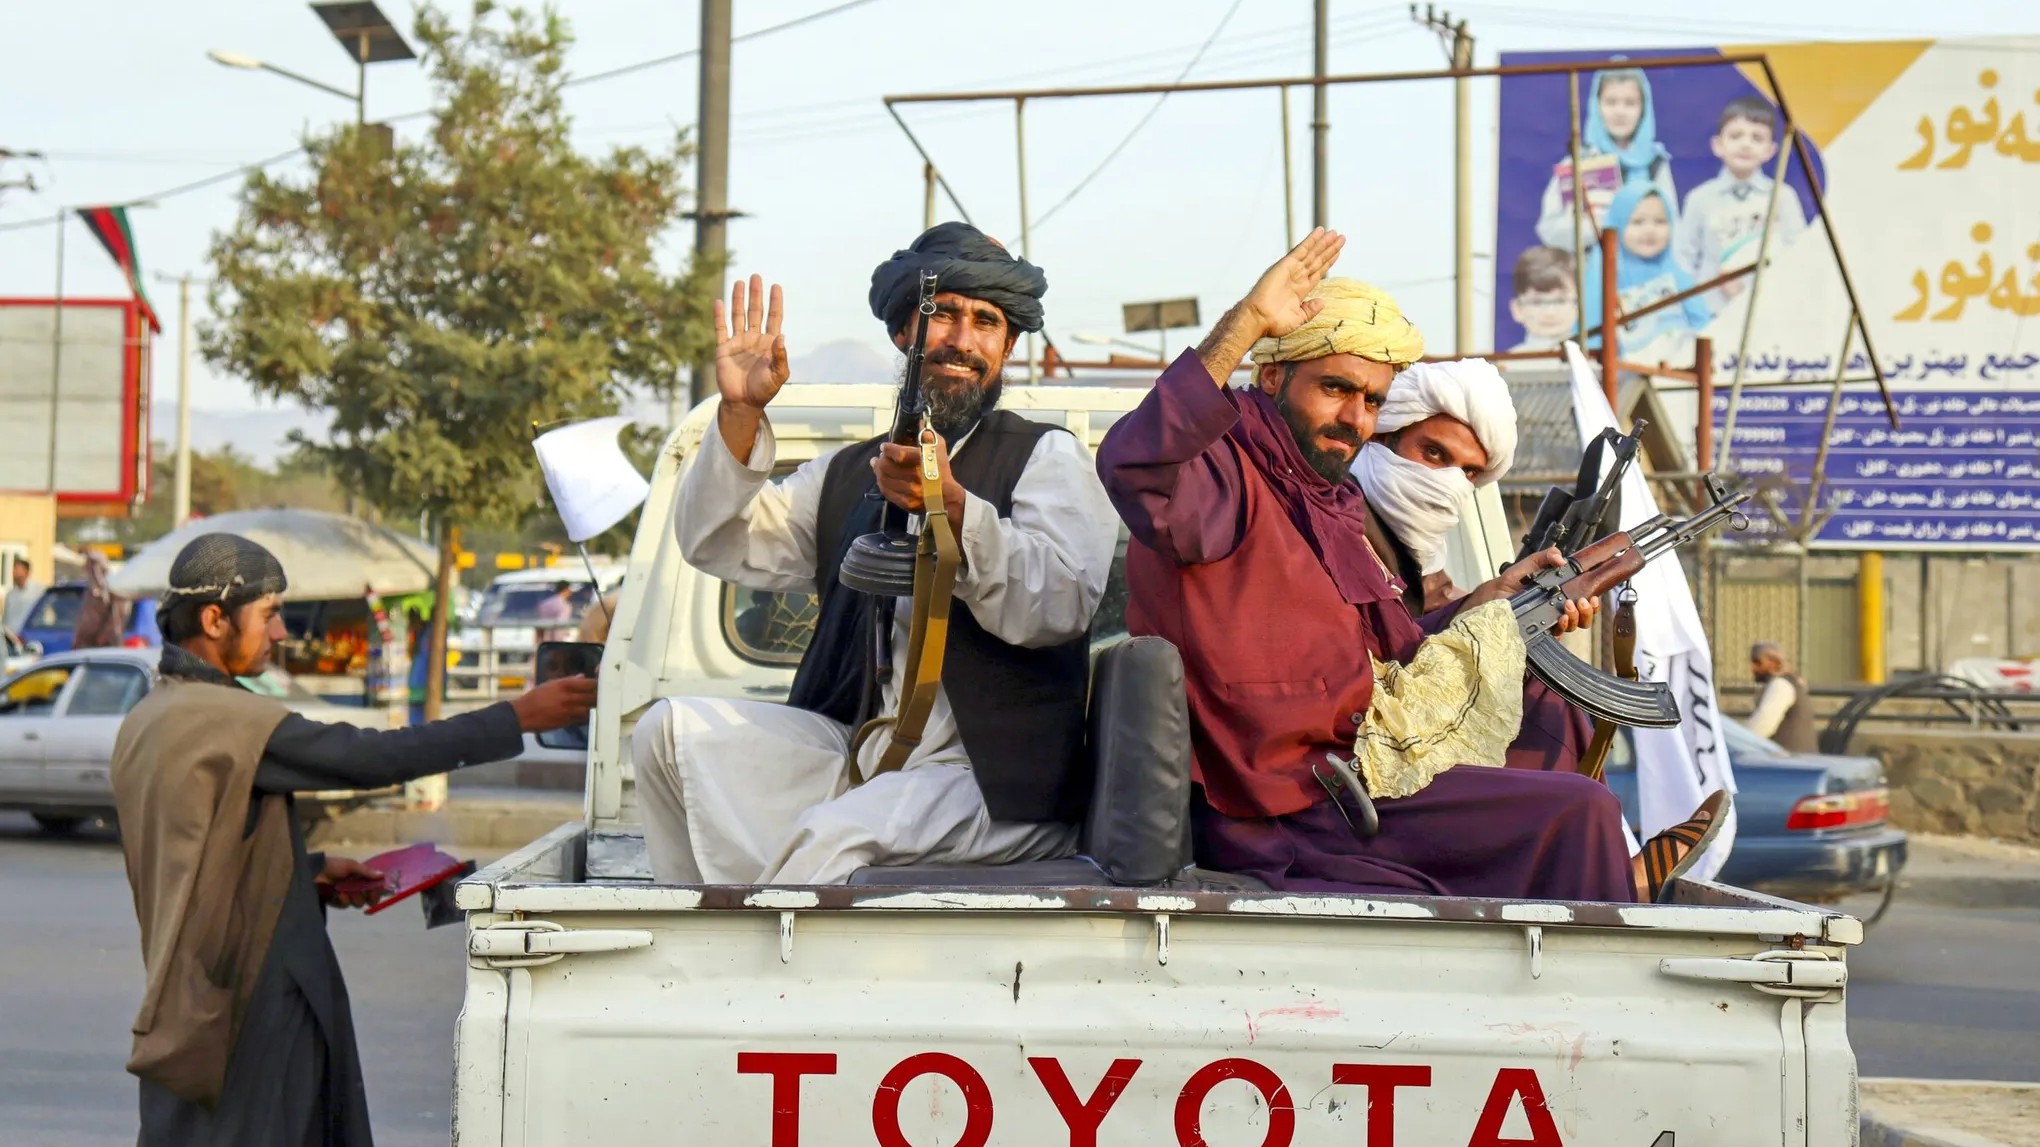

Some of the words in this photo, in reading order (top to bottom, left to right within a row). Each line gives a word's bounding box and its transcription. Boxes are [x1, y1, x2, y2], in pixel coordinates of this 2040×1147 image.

[1896, 69, 2000, 170] نور
[1891, 221, 1993, 322] نور
[737, 1052, 1563, 1147] TOYOTA
